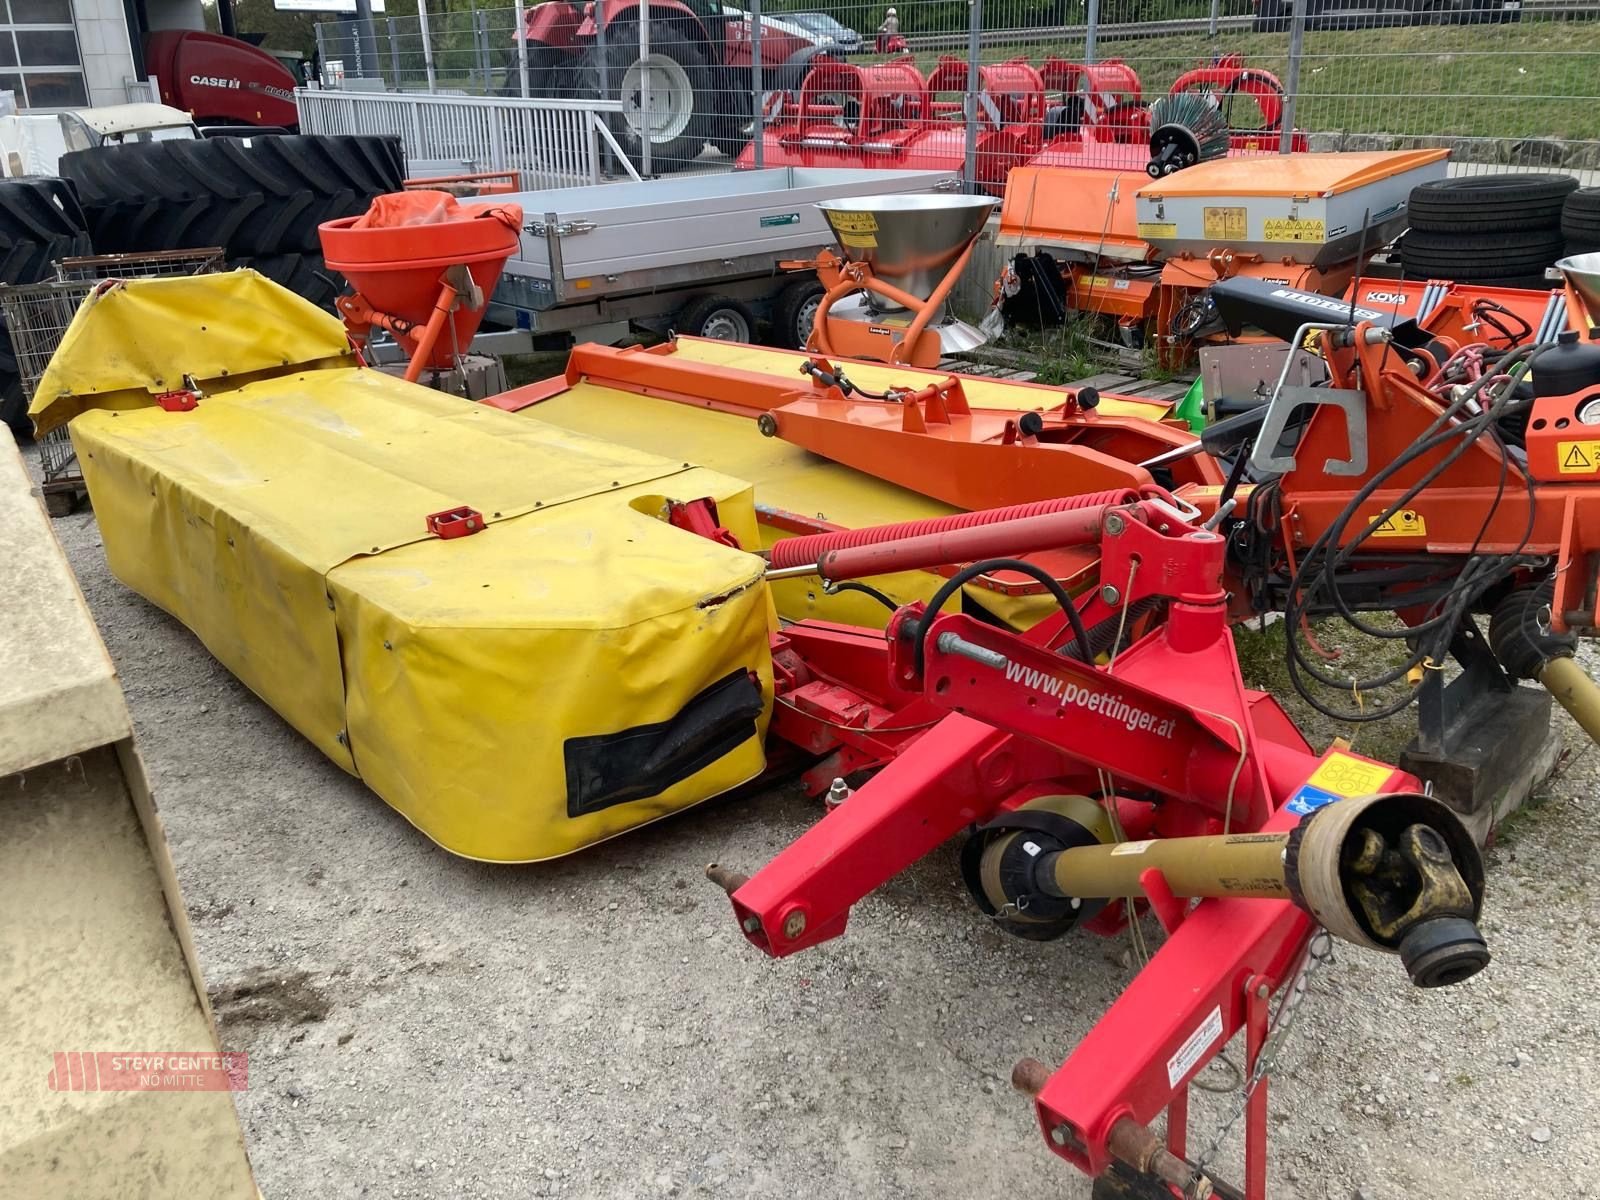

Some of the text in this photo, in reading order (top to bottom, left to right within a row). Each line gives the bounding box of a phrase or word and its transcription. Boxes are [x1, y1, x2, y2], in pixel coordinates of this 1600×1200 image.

[727, 19, 768, 37] STER
[190, 75, 228, 88] CASE
[1006, 660, 1176, 739] www.poettinger.at
